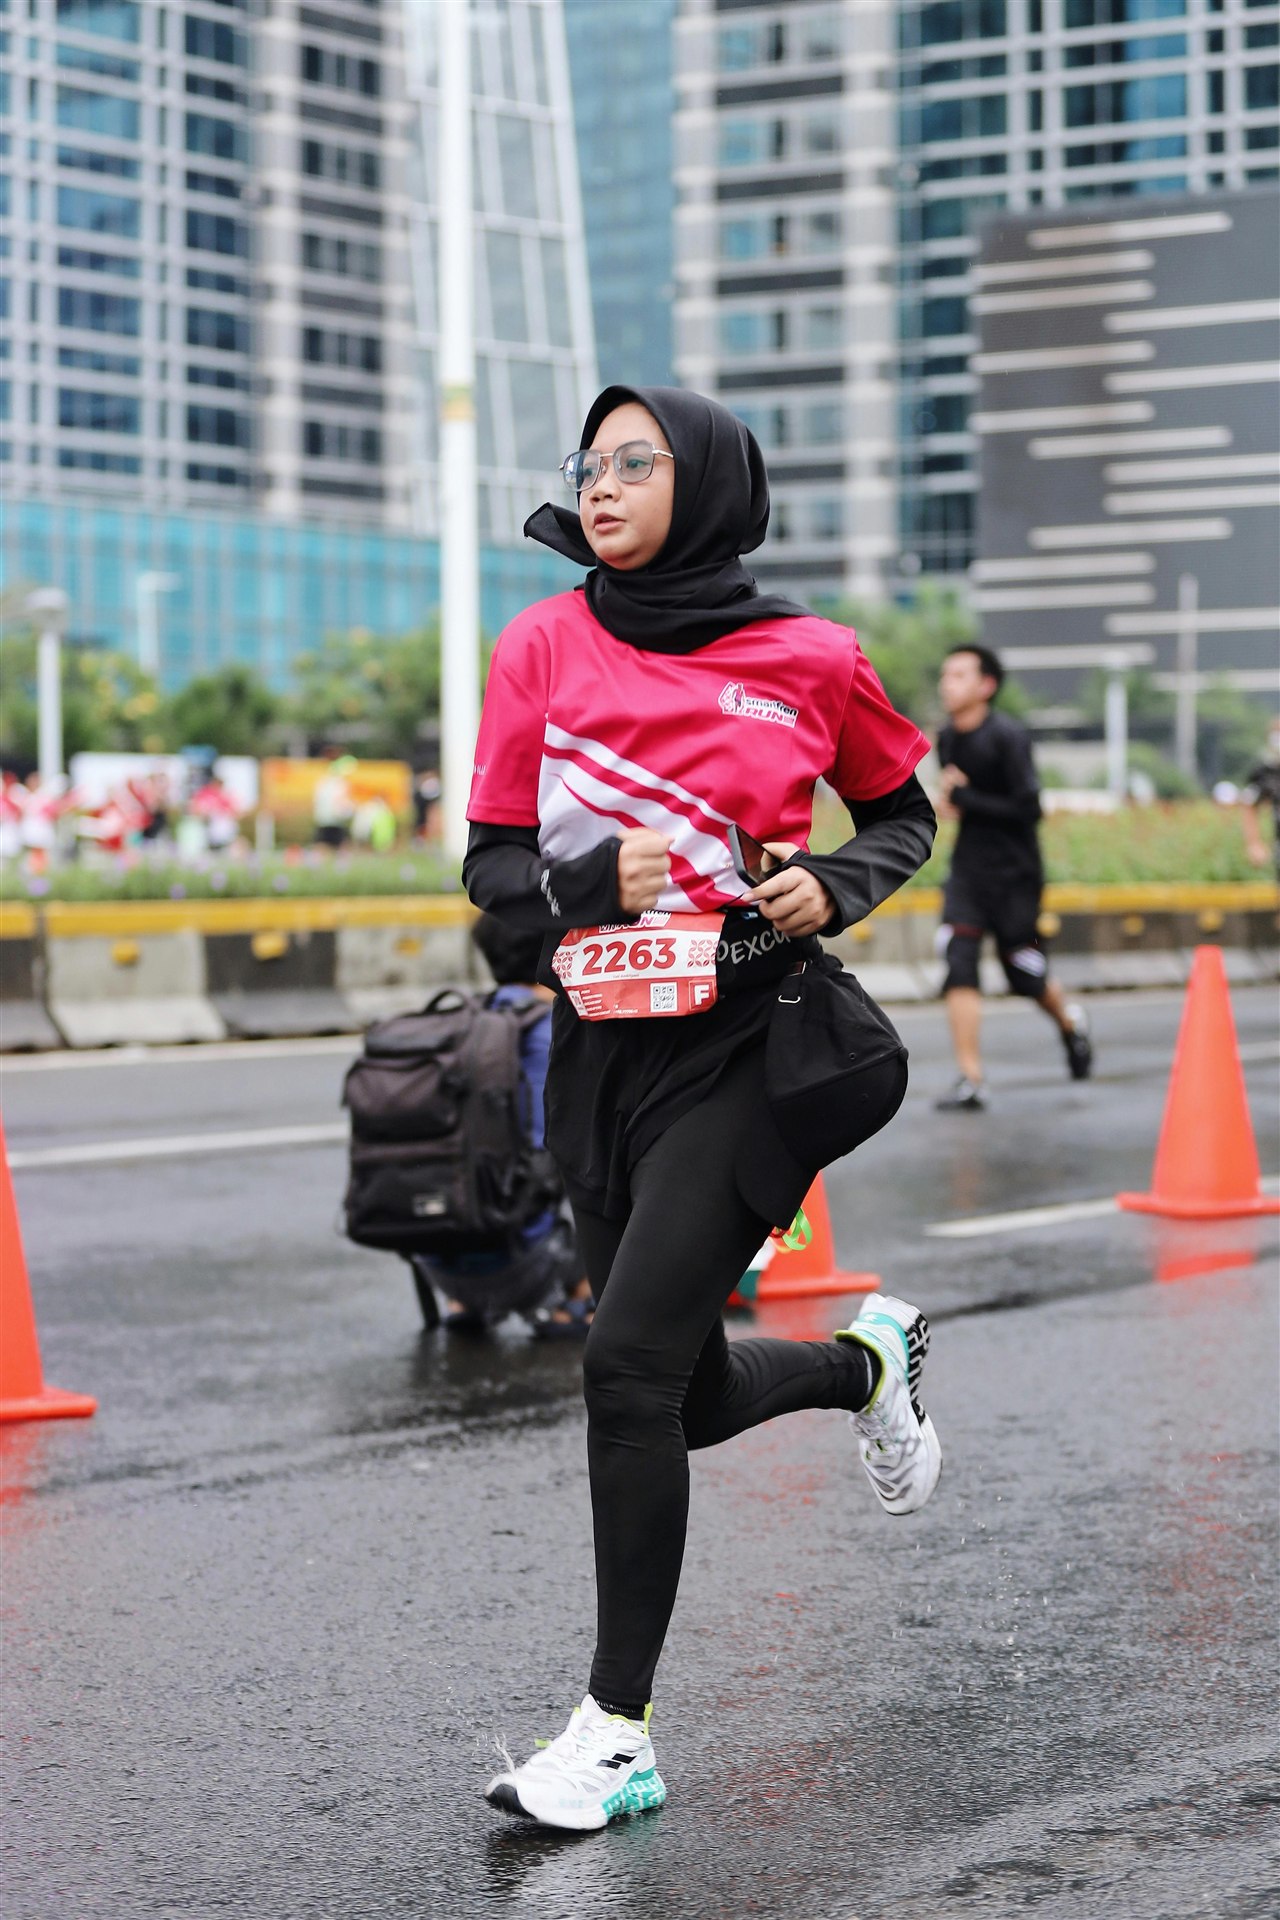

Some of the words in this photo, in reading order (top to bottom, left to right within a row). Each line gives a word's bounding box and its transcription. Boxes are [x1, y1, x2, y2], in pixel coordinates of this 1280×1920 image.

[745, 708, 784, 721] RUN
[582, 938, 677, 976] 2263
[694, 984, 710, 1006] F
